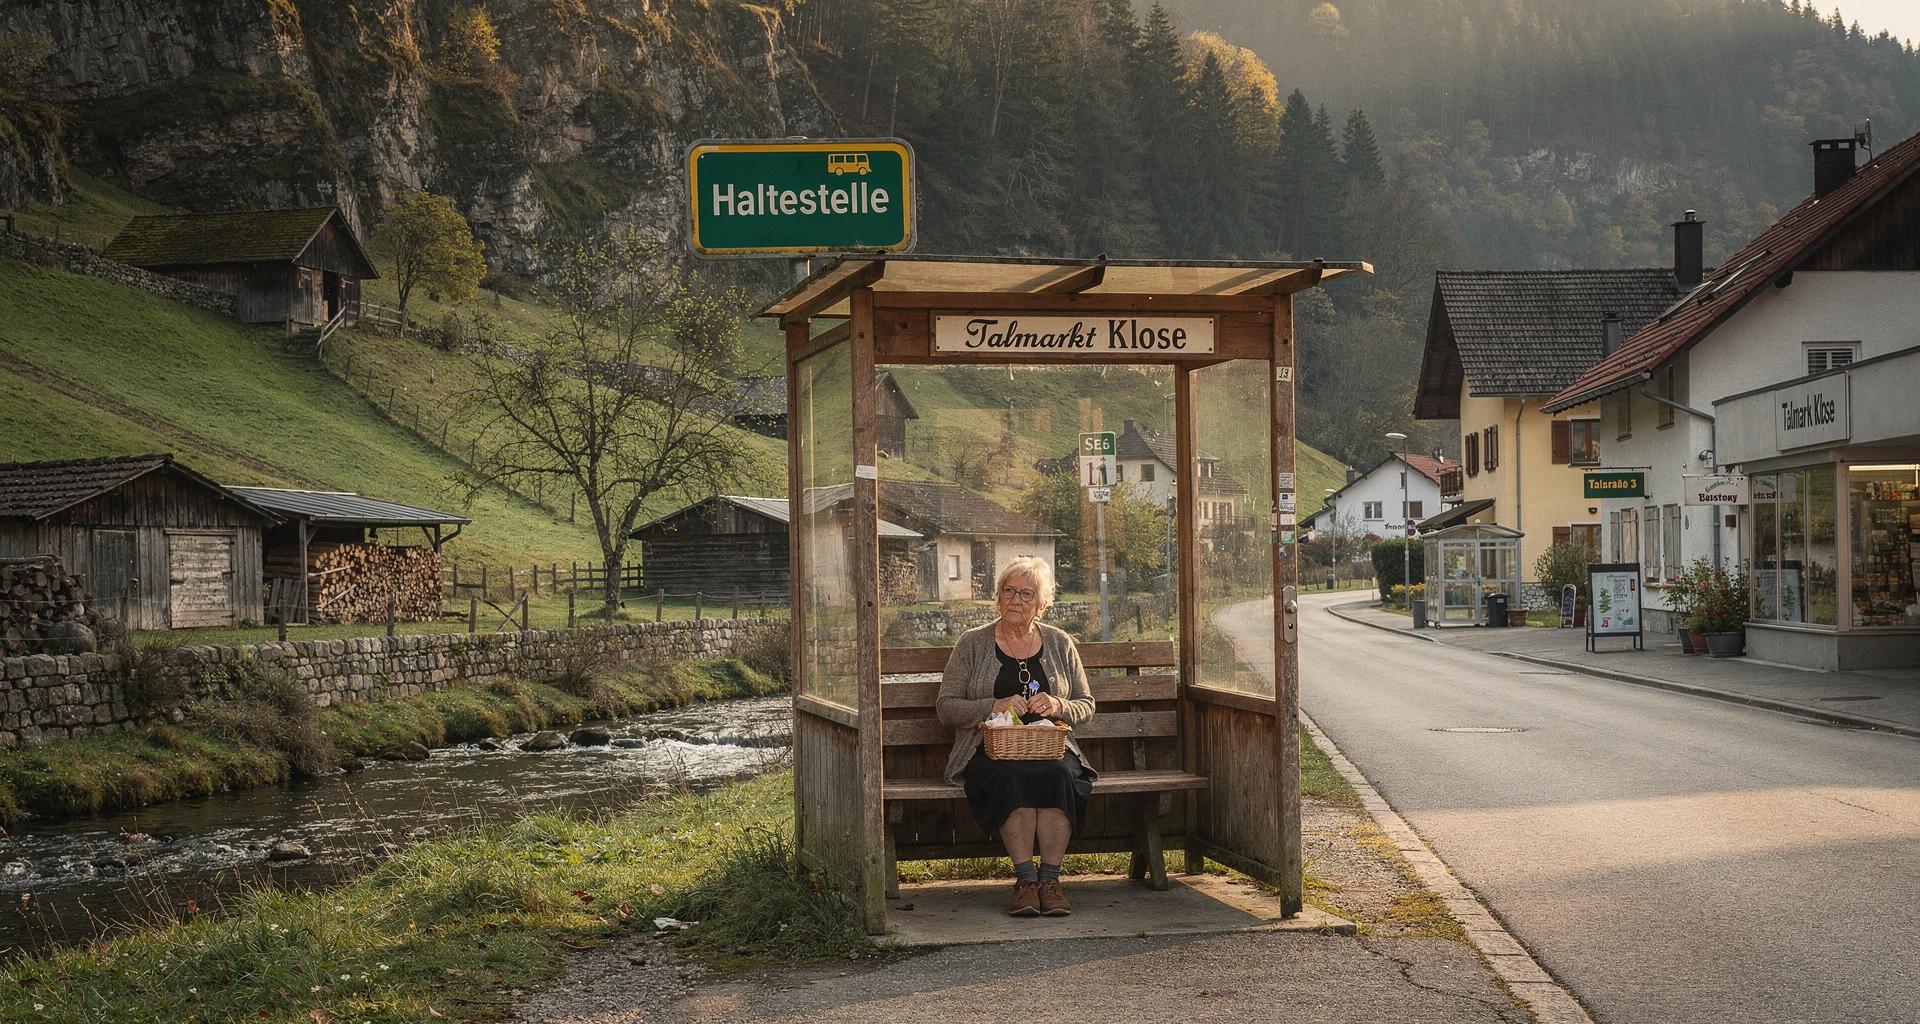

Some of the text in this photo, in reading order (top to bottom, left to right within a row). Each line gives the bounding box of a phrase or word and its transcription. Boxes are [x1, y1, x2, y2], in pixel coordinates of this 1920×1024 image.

[712, 182, 889, 216] Haltestelle
[965, 318, 1187, 349] Talmarkt Klose
[1781, 392, 1835, 432] Talmark Klose
[1084, 437, 1110, 451] SE6
